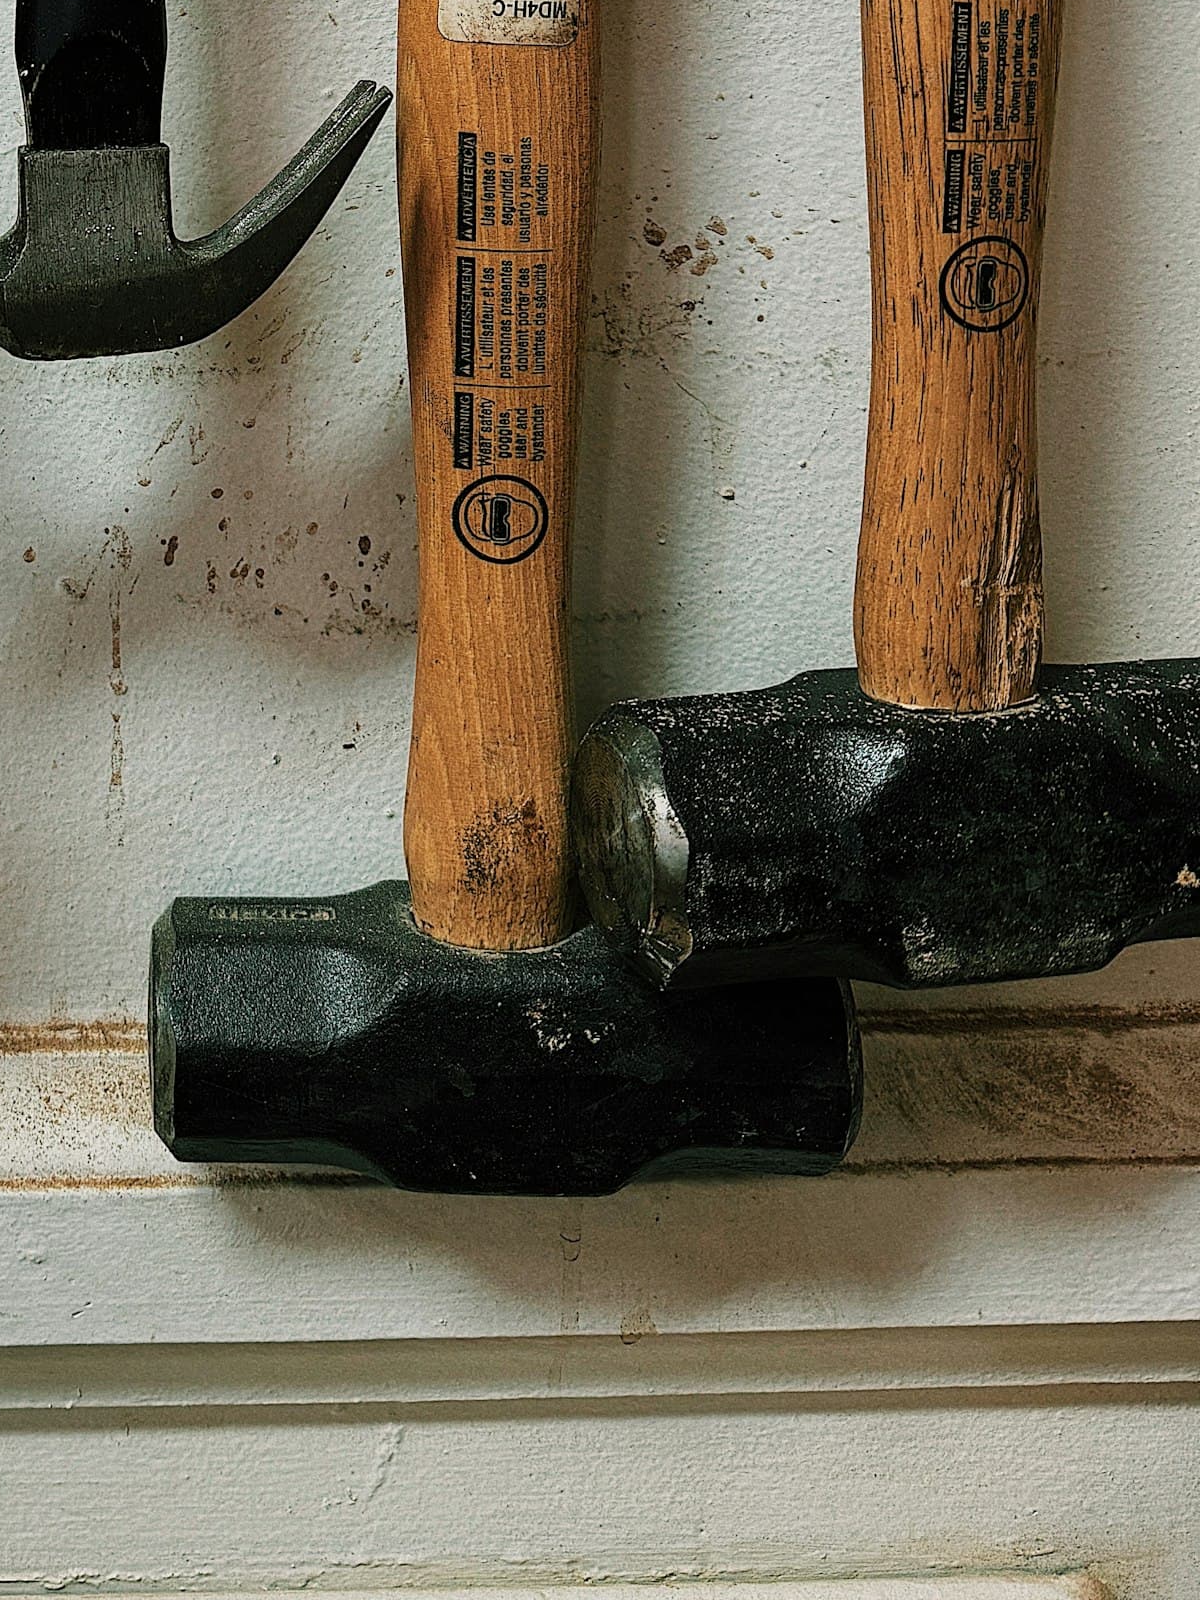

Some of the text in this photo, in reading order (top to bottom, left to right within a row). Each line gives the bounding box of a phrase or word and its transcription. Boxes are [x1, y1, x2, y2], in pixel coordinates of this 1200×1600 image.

[492, 0, 567, 18] MD4H-C
[980, 21, 991, 38] les
[953, 6, 968, 115] AVERTISSEMENT
[979, 42, 990, 52] et
[1009, 19, 1025, 122] doivent porter des
[1026, 63, 1037, 77] de
[462, 136, 475, 226] ADVERTENCIA
[481, 152, 495, 226] Use lentes de
[519, 137, 533, 188] personas
[535, 163, 548, 216] alrededor
[948, 153, 961, 216] WARNING
[500, 155, 516, 226] seguridad, el
[966, 153, 985, 229] Wear safety
[988, 166, 1001, 219] goggles,
[1004, 164, 1017, 219] user and
[1018, 160, 1032, 222] bystander
[518, 202, 531, 243] usuario
[481, 268, 494, 283] les
[482, 287, 494, 297] et
[461, 260, 473, 362] AVERTISSEMENT
[516, 268, 530, 371] doivent porter des
[533, 312, 546, 325] de
[500, 319, 513, 378] personnes
[532, 330, 545, 374] lunettes
[459, 395, 471, 454] WARNING
[478, 398, 495, 466] Wear safety
[498, 408, 513, 458] goggles,
[515, 408, 528, 458] user and
[531, 404, 546, 461] bystander
